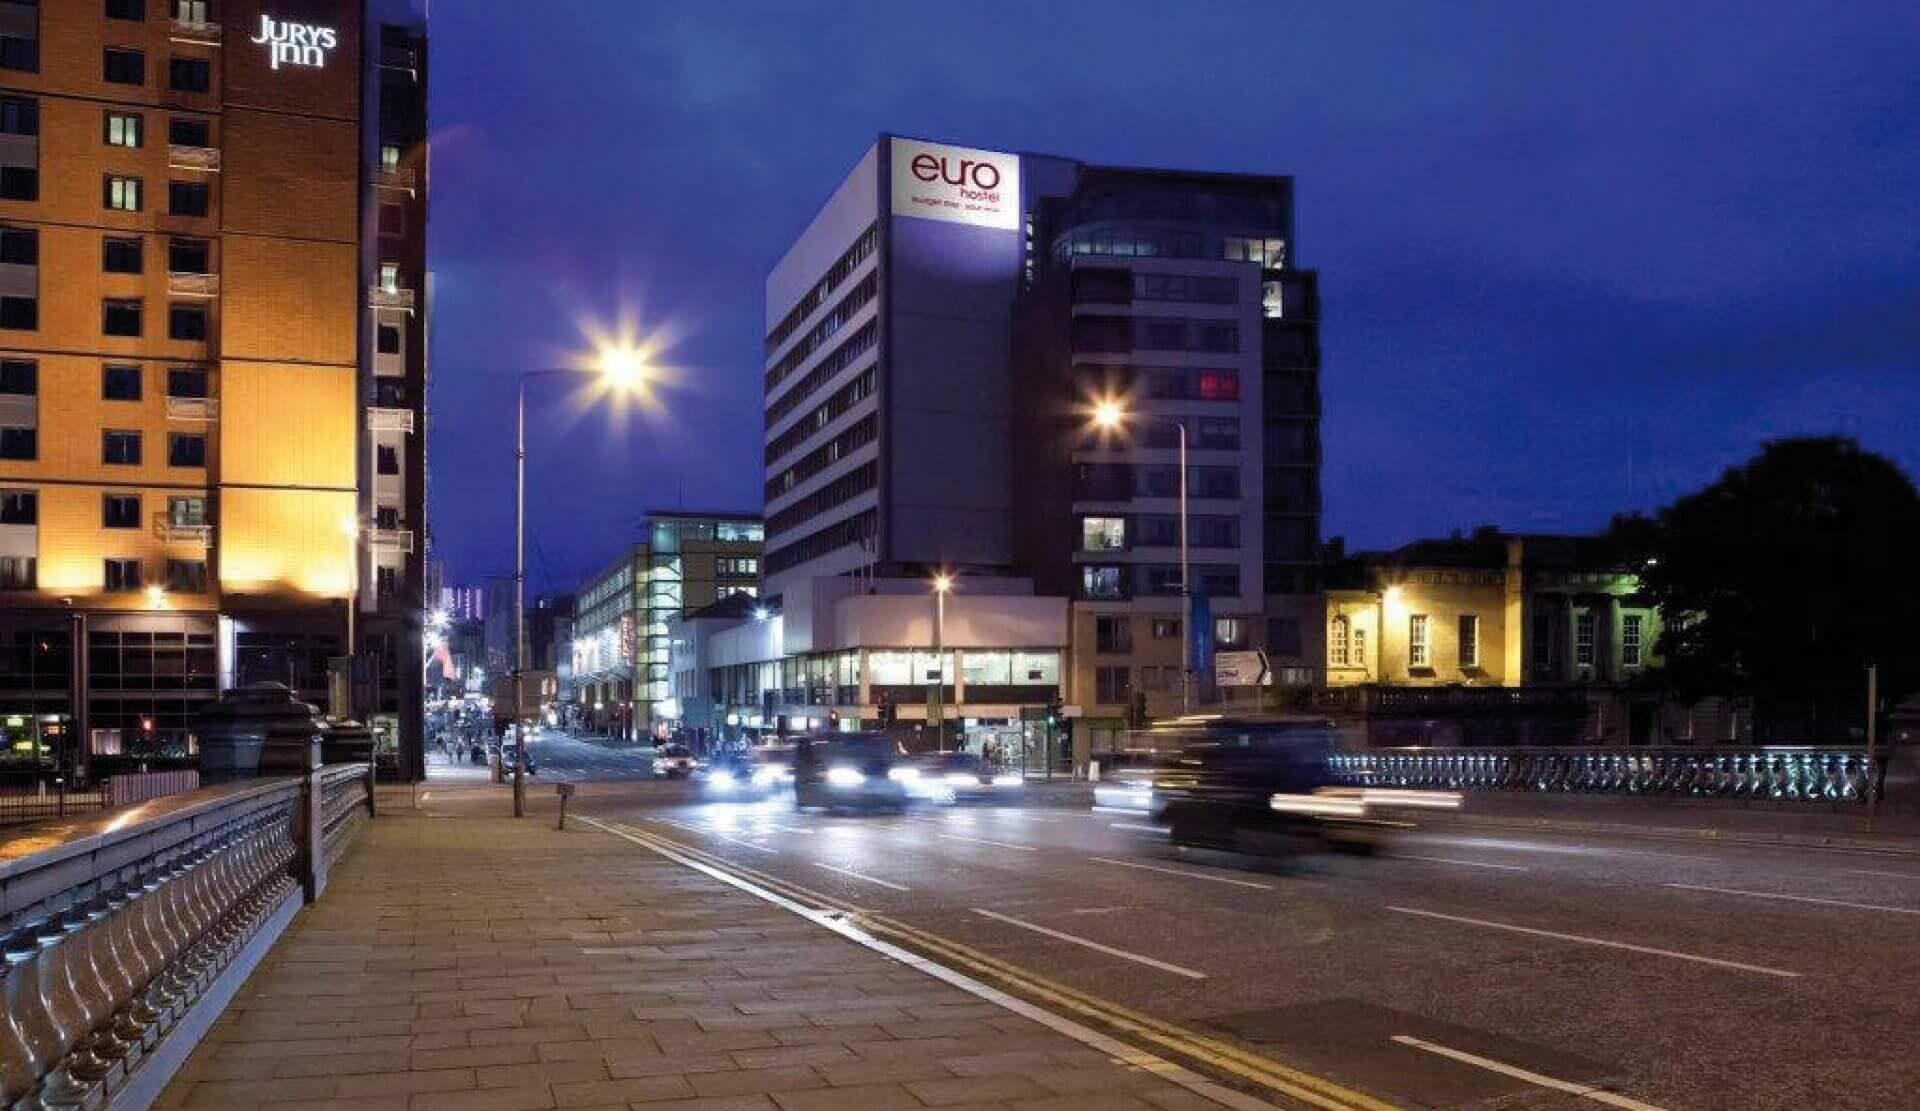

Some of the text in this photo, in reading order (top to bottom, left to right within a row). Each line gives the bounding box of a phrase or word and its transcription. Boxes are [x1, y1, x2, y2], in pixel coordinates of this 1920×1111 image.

[270, 40, 324, 70] Inn
[911, 153, 999, 189] euro
[960, 188, 1000, 203] hostel
